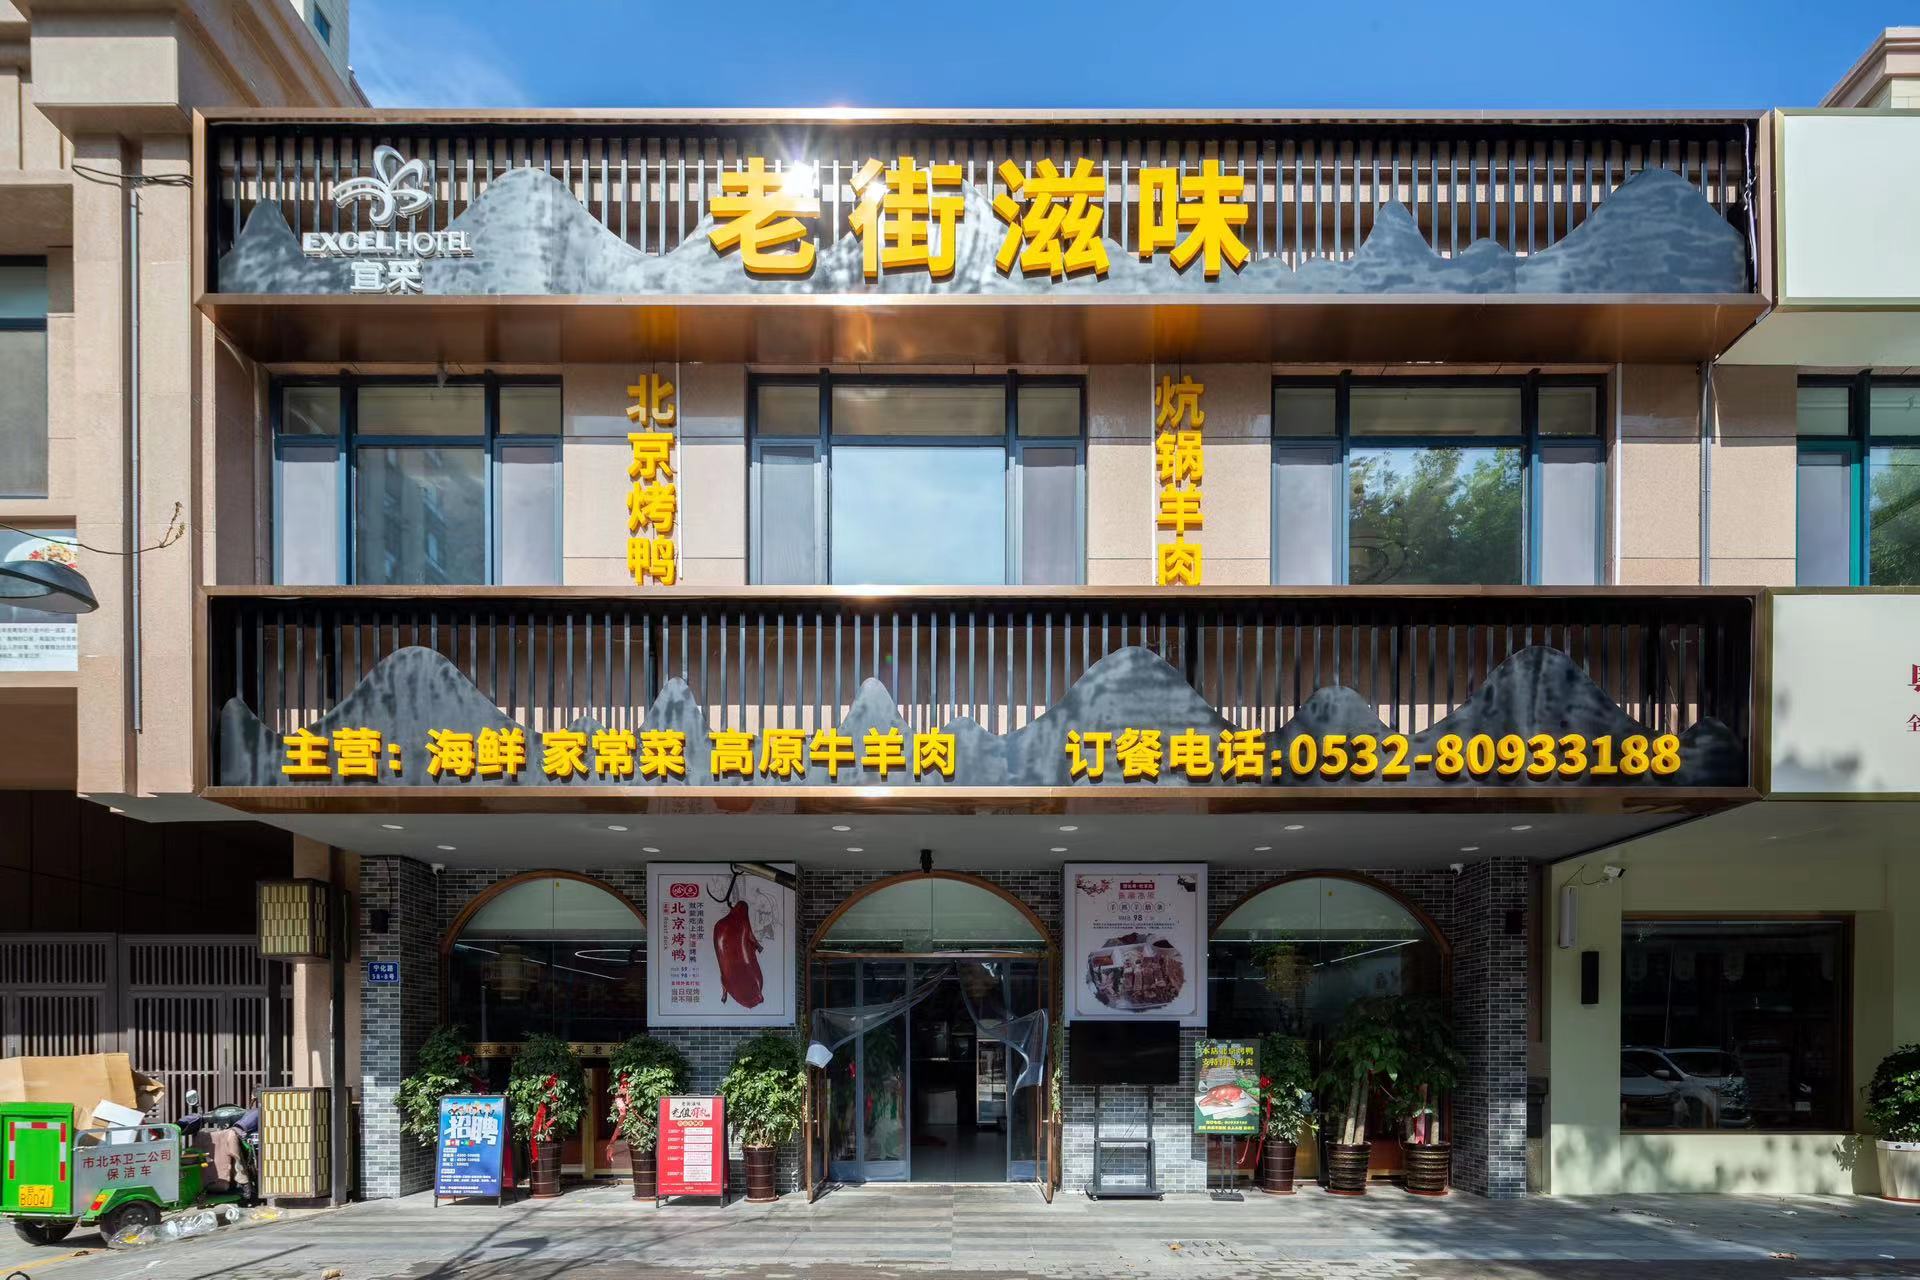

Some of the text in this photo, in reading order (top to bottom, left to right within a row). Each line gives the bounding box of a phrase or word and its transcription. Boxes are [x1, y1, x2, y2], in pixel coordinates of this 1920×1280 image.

[708, 156, 1248, 278] 老街滋味
[350, 259, 424, 295] 宜采
[625, 373, 677, 586] 北京烤鸭
[1155, 375, 1205, 586] 炕锅羊肉
[671, 902, 686, 961] 北京烤鸭
[373, 964, 394, 972] 宁化路
[444, 1115, 498, 1145] 招聘
[82, 1149, 172, 1169] 市北环卫二公司
[107, 1165, 152, 1181] 保洁车
